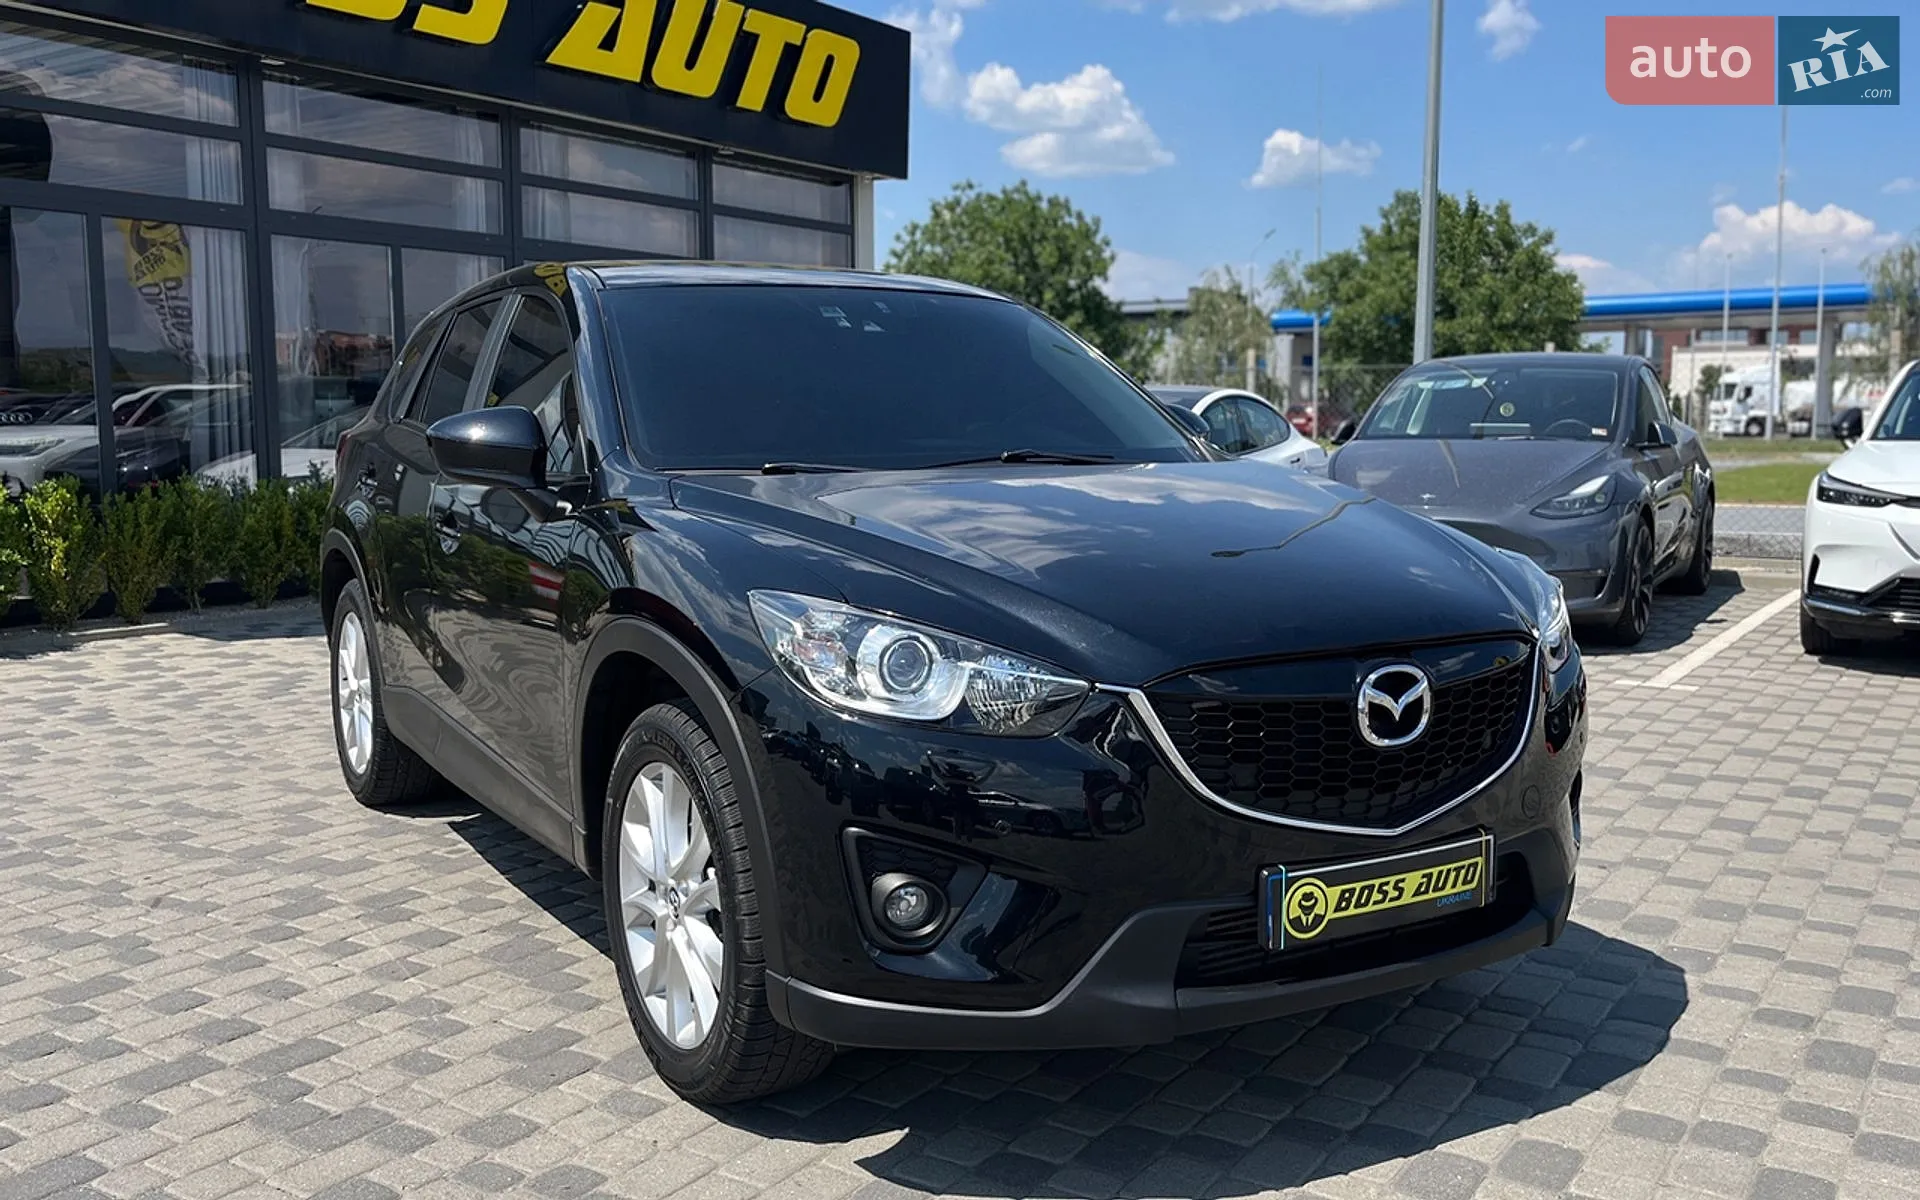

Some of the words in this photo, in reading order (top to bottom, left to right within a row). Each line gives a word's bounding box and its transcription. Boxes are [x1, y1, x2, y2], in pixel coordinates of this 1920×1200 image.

[545, 0, 861, 127] AUTO
[1333, 877, 1408, 914] BOSS
[1411, 861, 1479, 898] AUTO
